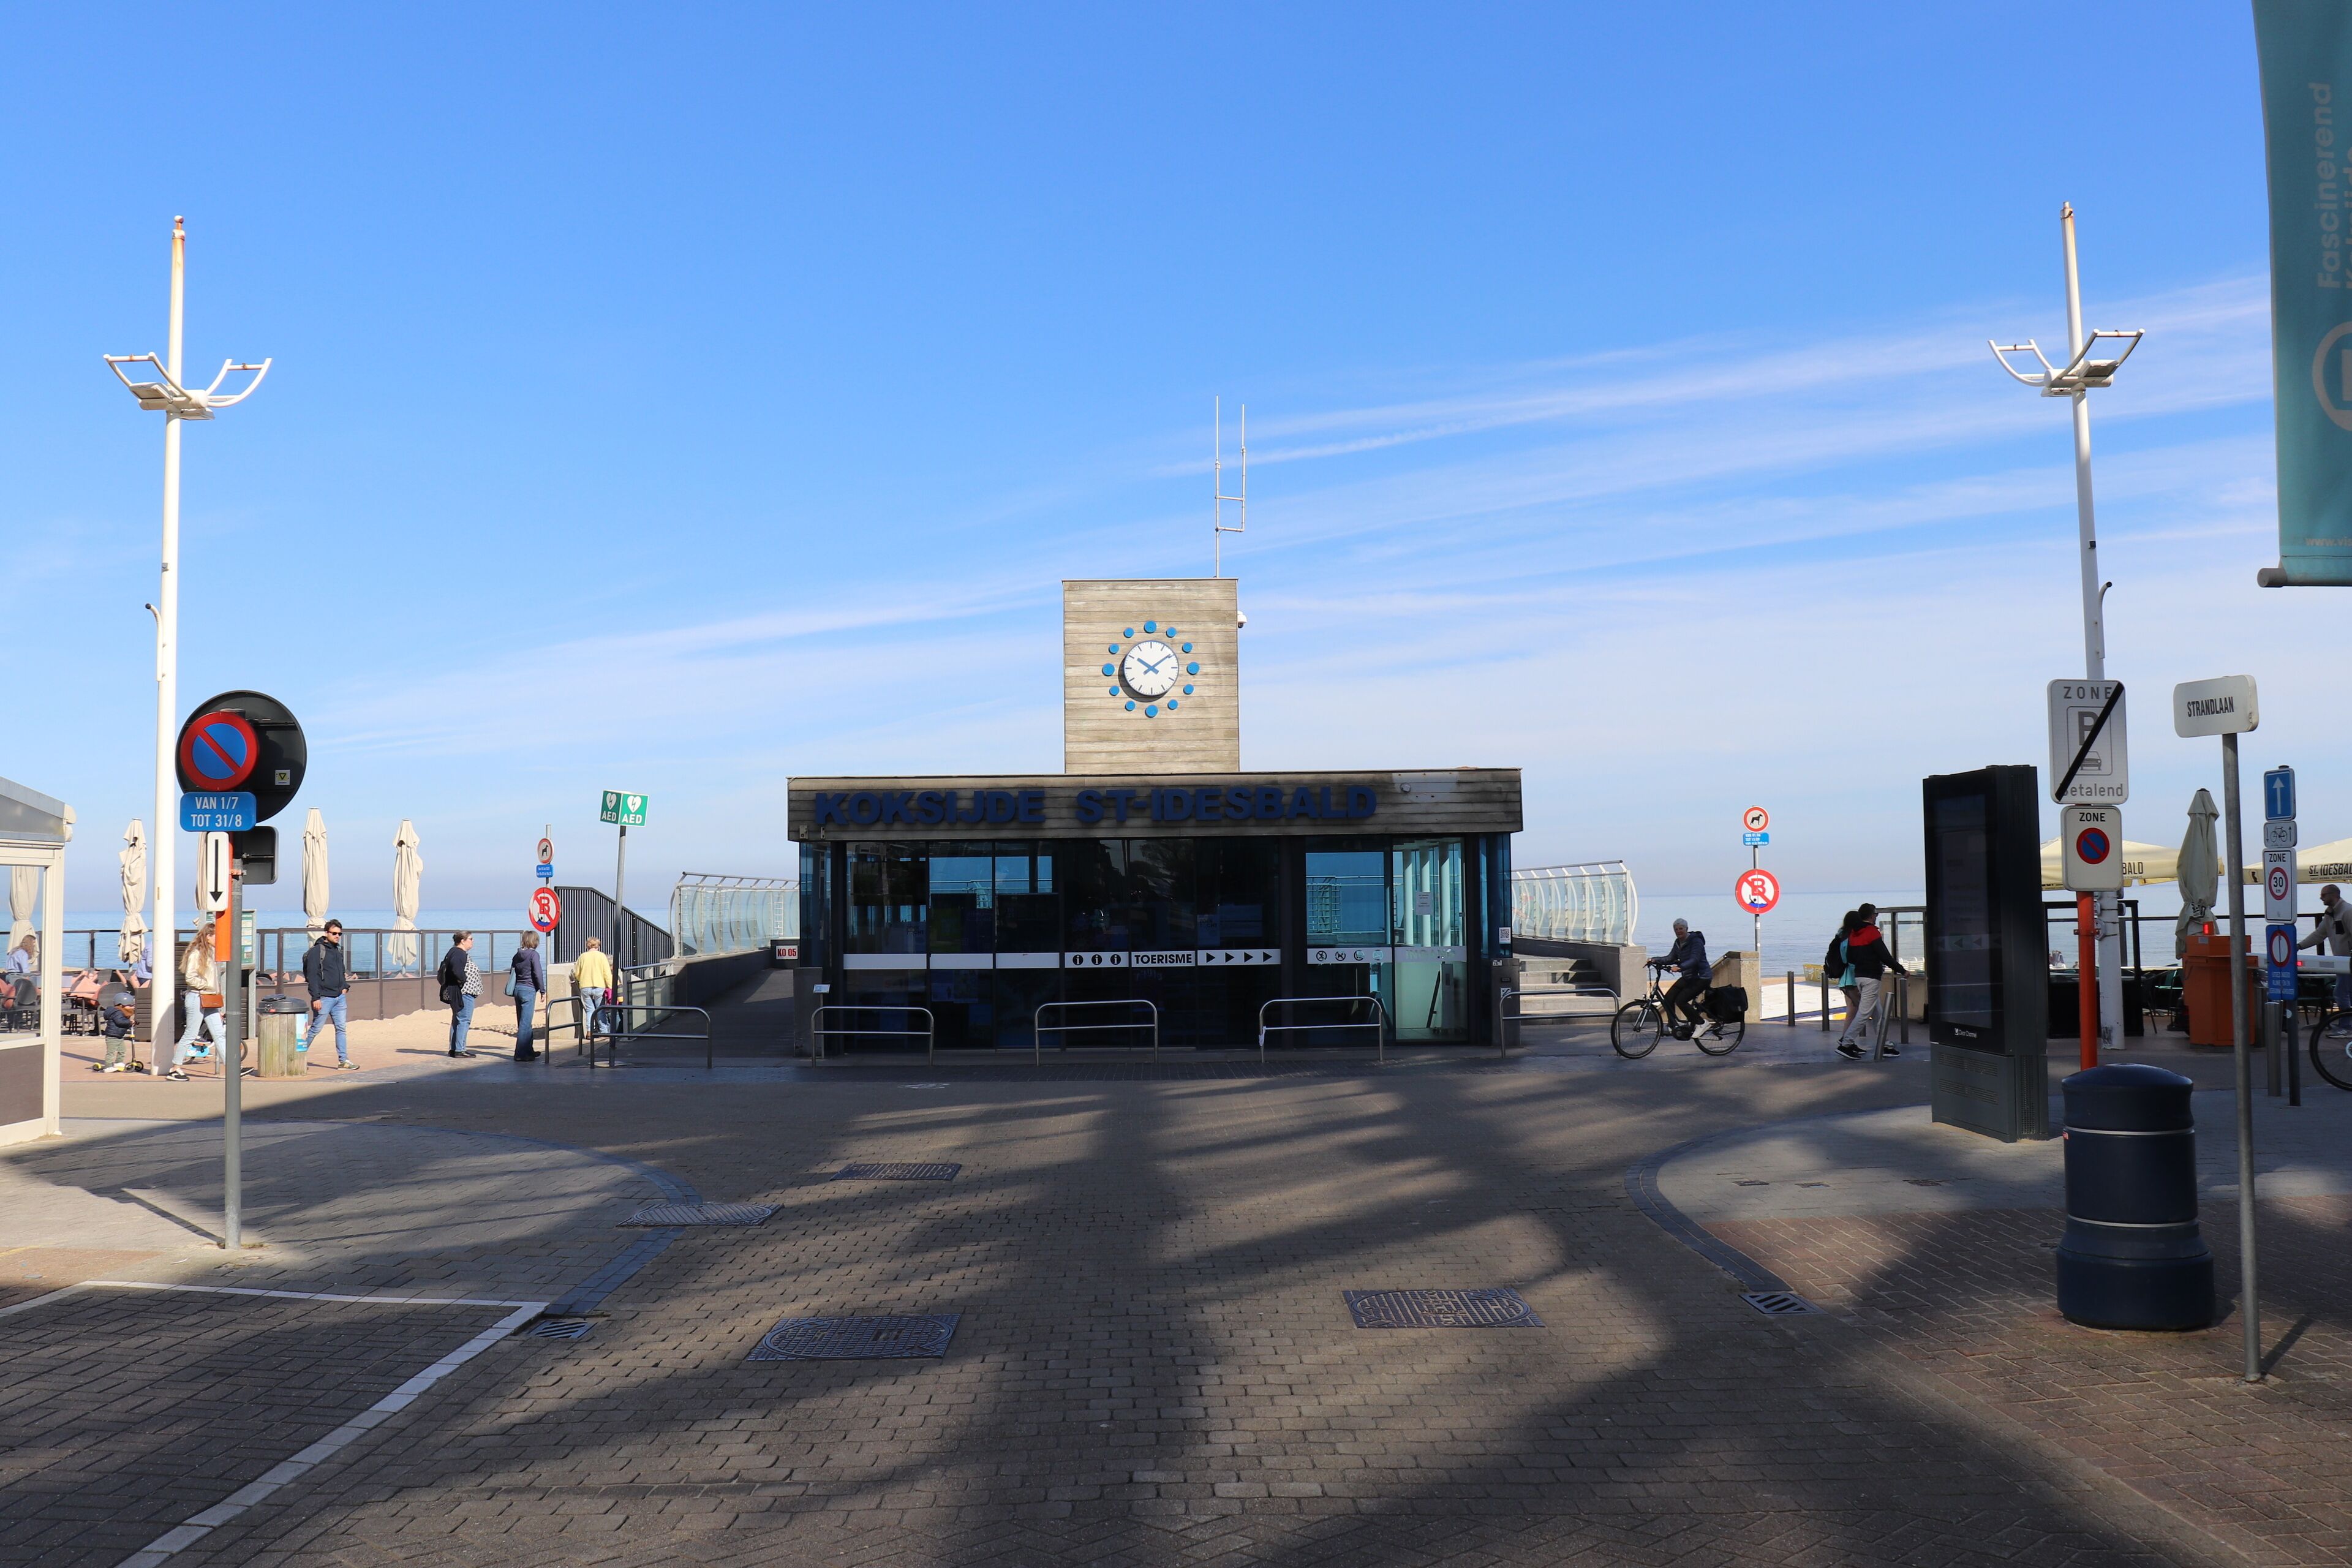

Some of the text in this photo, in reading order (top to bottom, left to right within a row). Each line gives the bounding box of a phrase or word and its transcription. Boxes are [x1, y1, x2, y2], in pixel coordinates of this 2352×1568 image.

[2308, 83, 2341, 289] Fascinerend
[2064, 686, 2113, 699] ZONE
[2187, 696, 2234, 717] STRANDLAAN
[2061, 783, 2123, 796] etalend
[195, 796, 239, 809] VAN 1/7
[815, 786, 1378, 825] KOKSIJDE ST-IDESBALD
[190, 814, 242, 827] TOT 31/8
[601, 810, 617, 821] AED
[621, 813, 643, 824] AED
[2079, 812, 2106, 822] ZONE
[2269, 853, 2286, 862] ZONE
[2273, 876, 2283, 888] 30
[777, 948, 796, 957] KO 05
[1134, 954, 1192, 965] TOERISME
